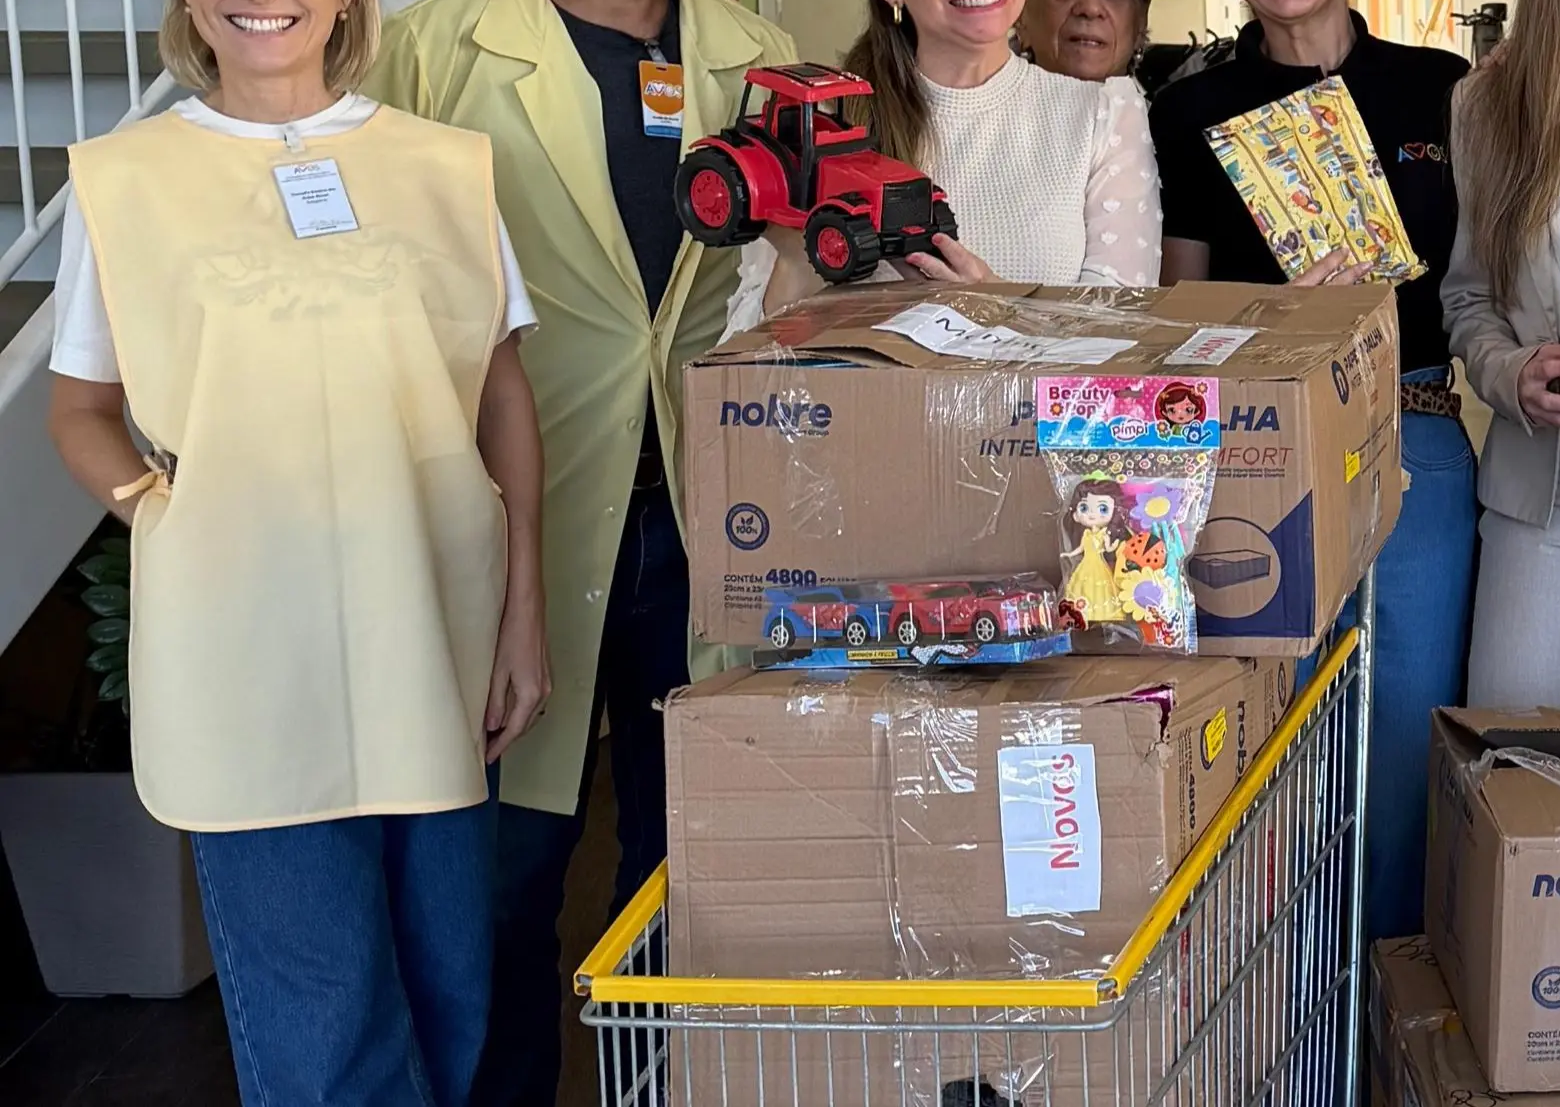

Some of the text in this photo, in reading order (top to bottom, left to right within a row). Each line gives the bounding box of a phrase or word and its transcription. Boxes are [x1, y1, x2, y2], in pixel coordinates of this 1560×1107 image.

[1049, 386, 1110, 403] Beauty
[720, 394, 832, 427] nobre
[1112, 422, 1149, 437] pimpi
[724, 573, 763, 583] CONTÉM
[766, 568, 817, 587] 4800
